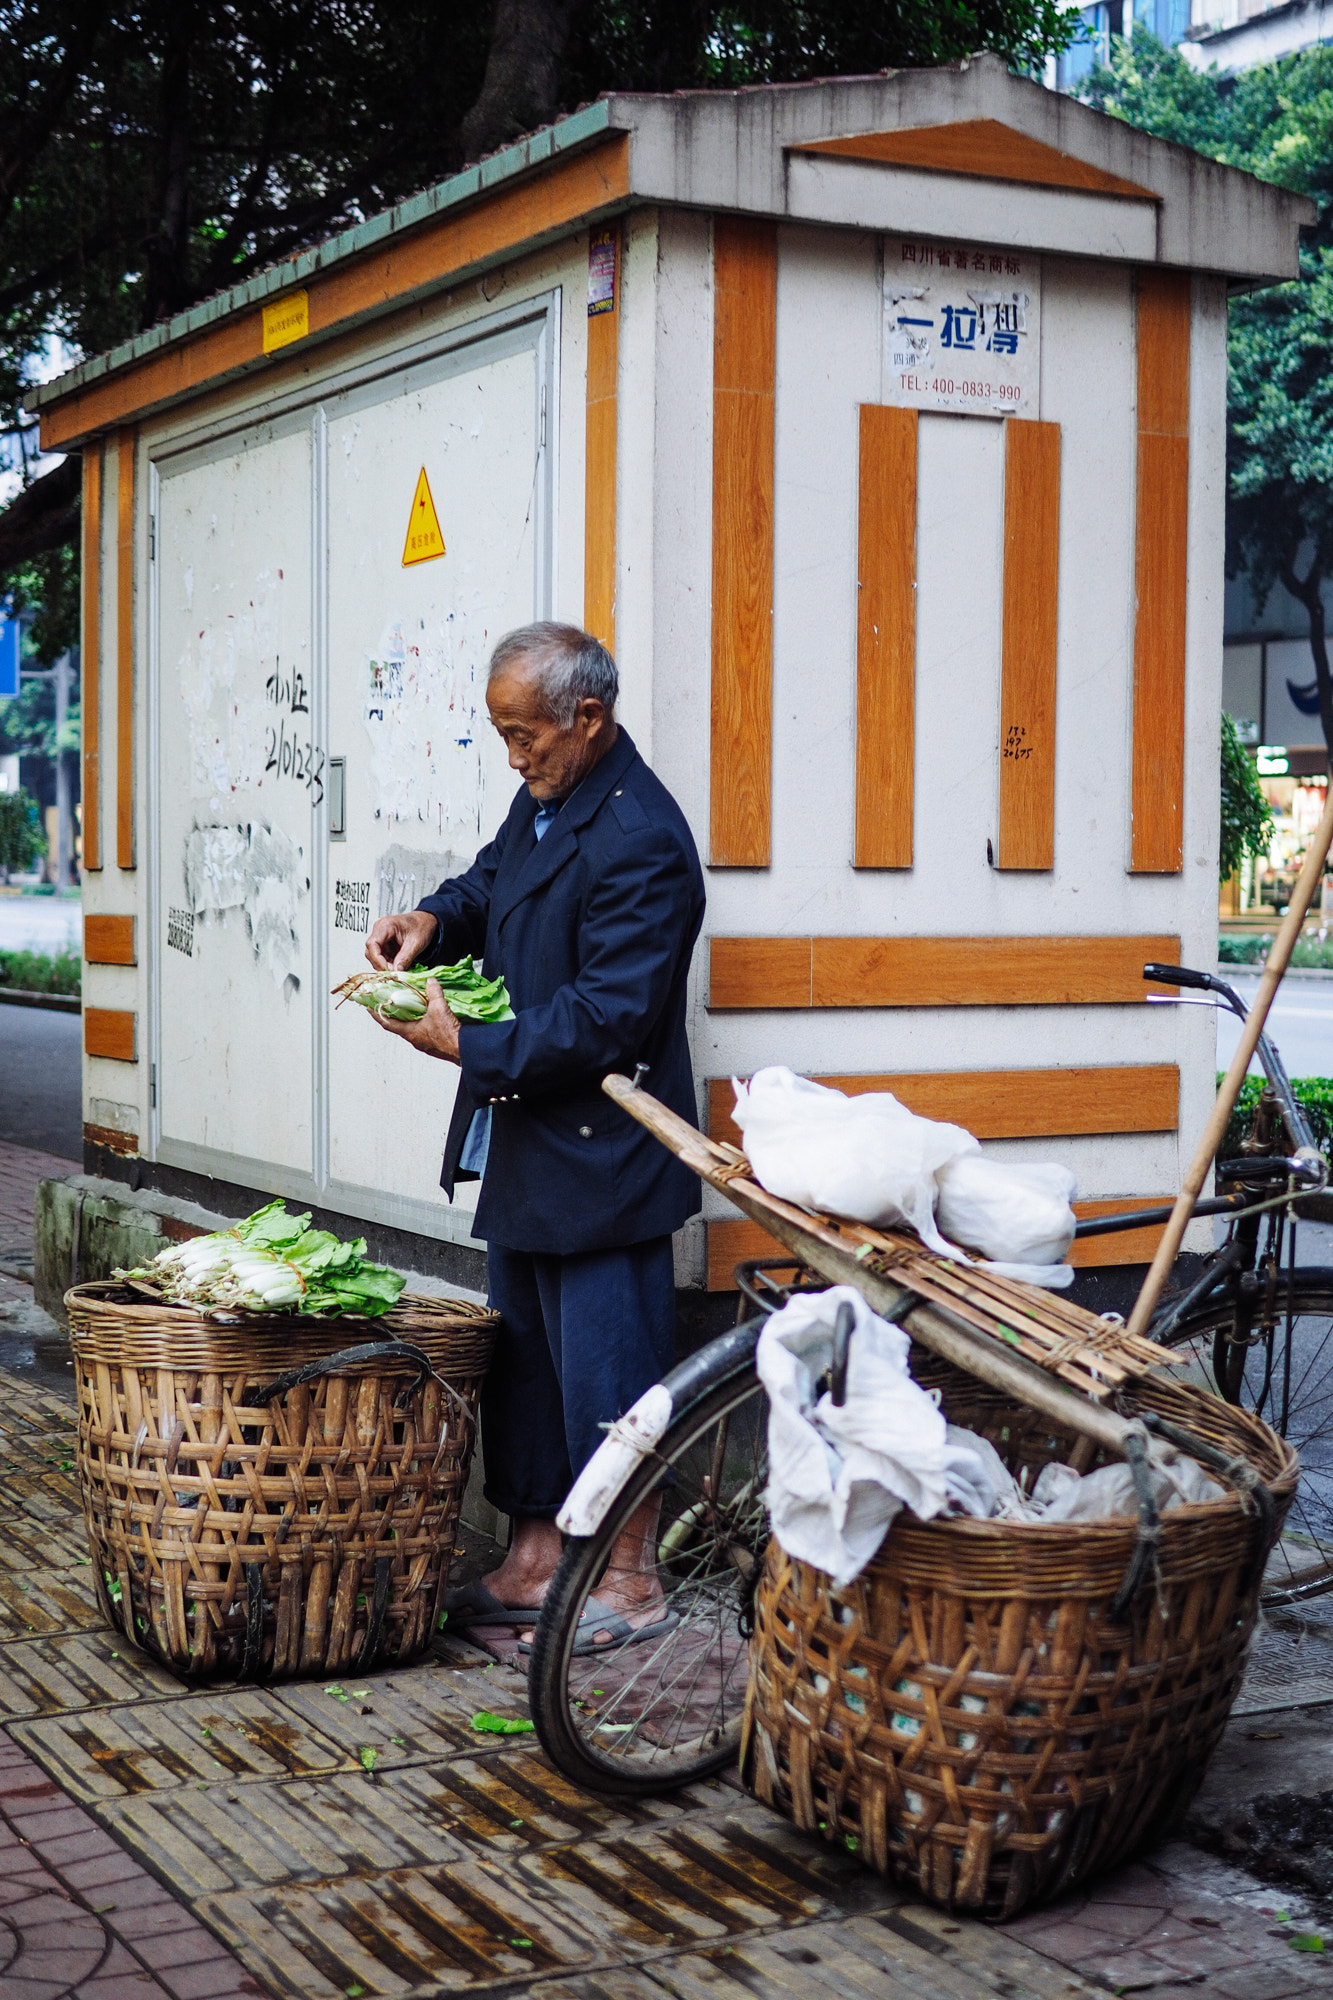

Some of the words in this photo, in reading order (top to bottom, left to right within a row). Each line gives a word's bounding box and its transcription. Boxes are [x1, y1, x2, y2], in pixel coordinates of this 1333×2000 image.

[901, 243, 1021, 275] 四川省著名商标
